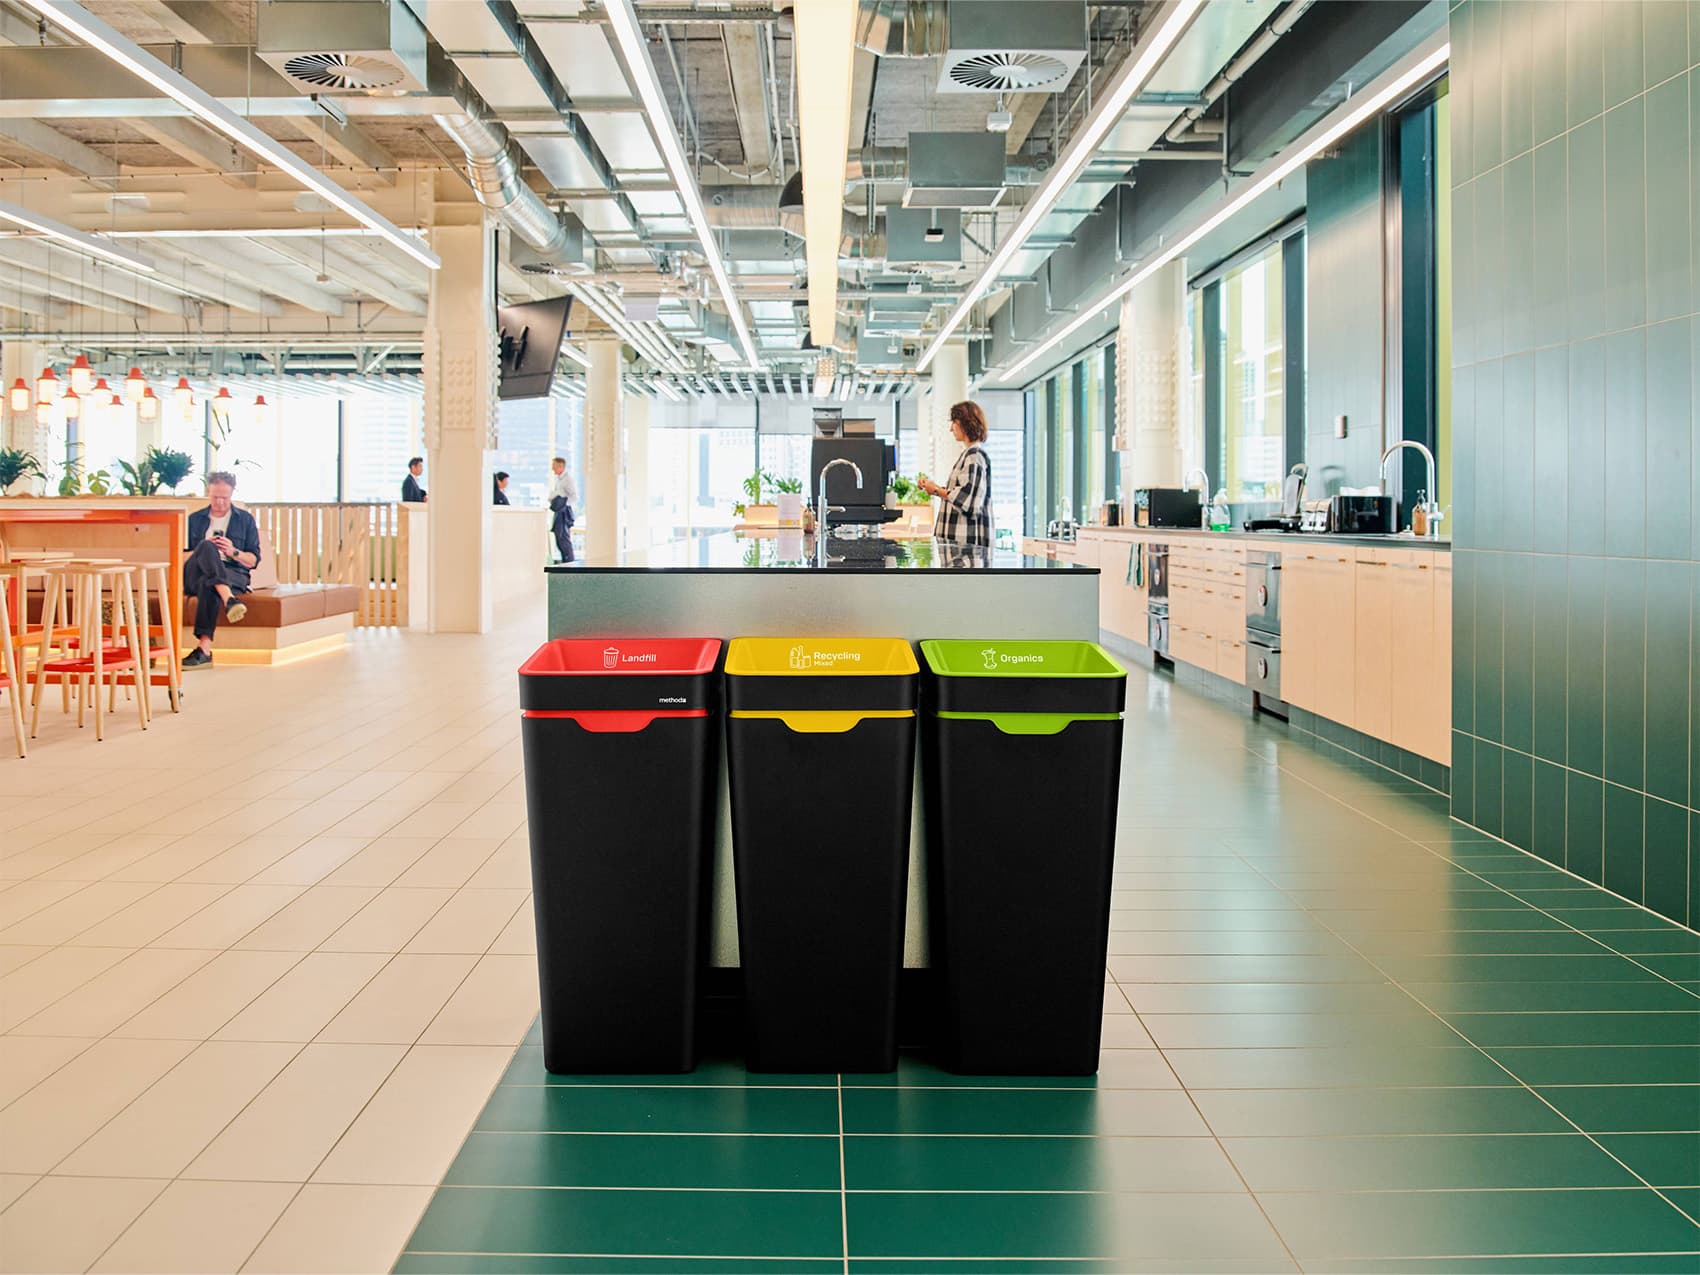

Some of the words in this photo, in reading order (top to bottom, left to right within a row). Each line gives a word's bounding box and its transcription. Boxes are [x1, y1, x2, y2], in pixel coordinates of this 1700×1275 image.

[622, 654, 656, 662] Landfill
[814, 651, 860, 661] Recycling
[1000, 654, 1043, 663] Organics
